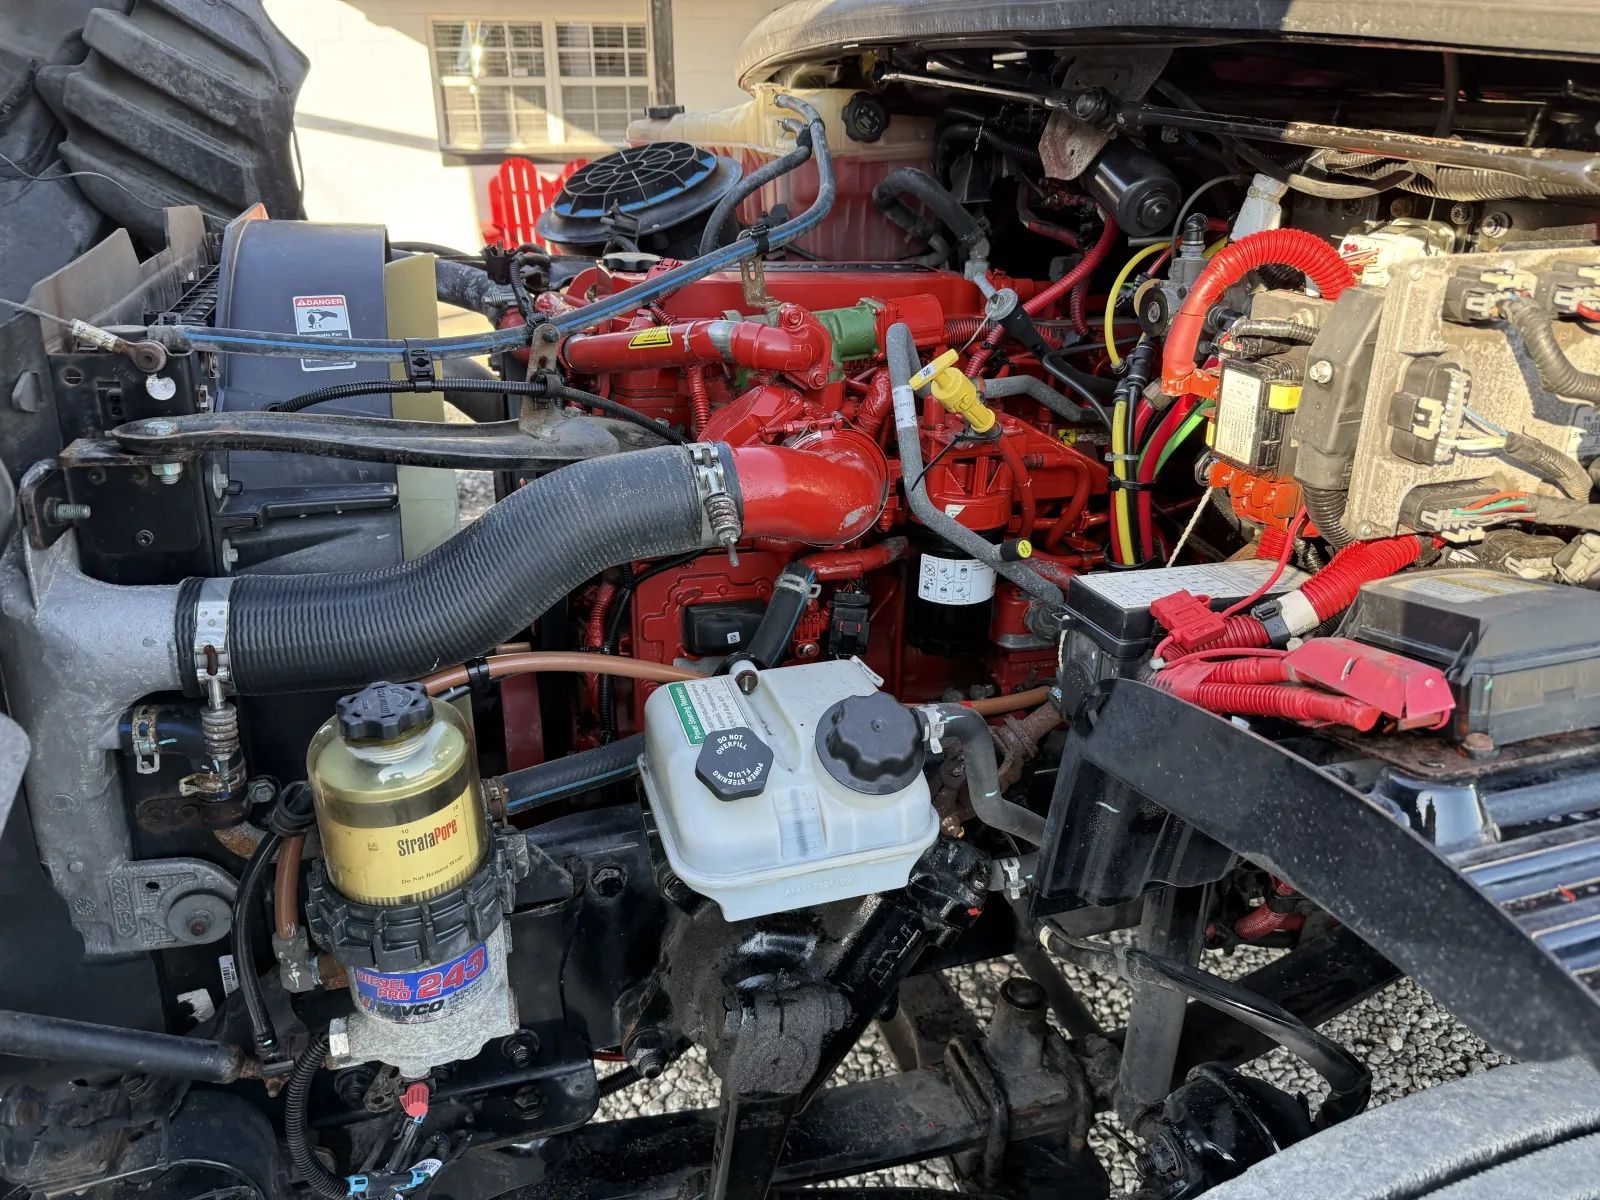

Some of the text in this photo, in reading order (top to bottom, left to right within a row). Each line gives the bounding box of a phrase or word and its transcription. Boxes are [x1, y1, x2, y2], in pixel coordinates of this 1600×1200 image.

[306, 298, 343, 306] DANGER
[717, 735, 727, 744] DO
[716, 741, 748, 755] OVERFILL
[713, 762, 764, 786] POWER STEERING
[728, 768, 751, 778] FLUID
[397, 818, 458, 857] StrataPore
[426, 865, 449, 878] Remove
[356, 969, 410, 989] DIESEL
[416, 946, 485, 999] 243
[377, 987, 412, 1000] PRO
[376, 1000, 445, 1020] VCO
